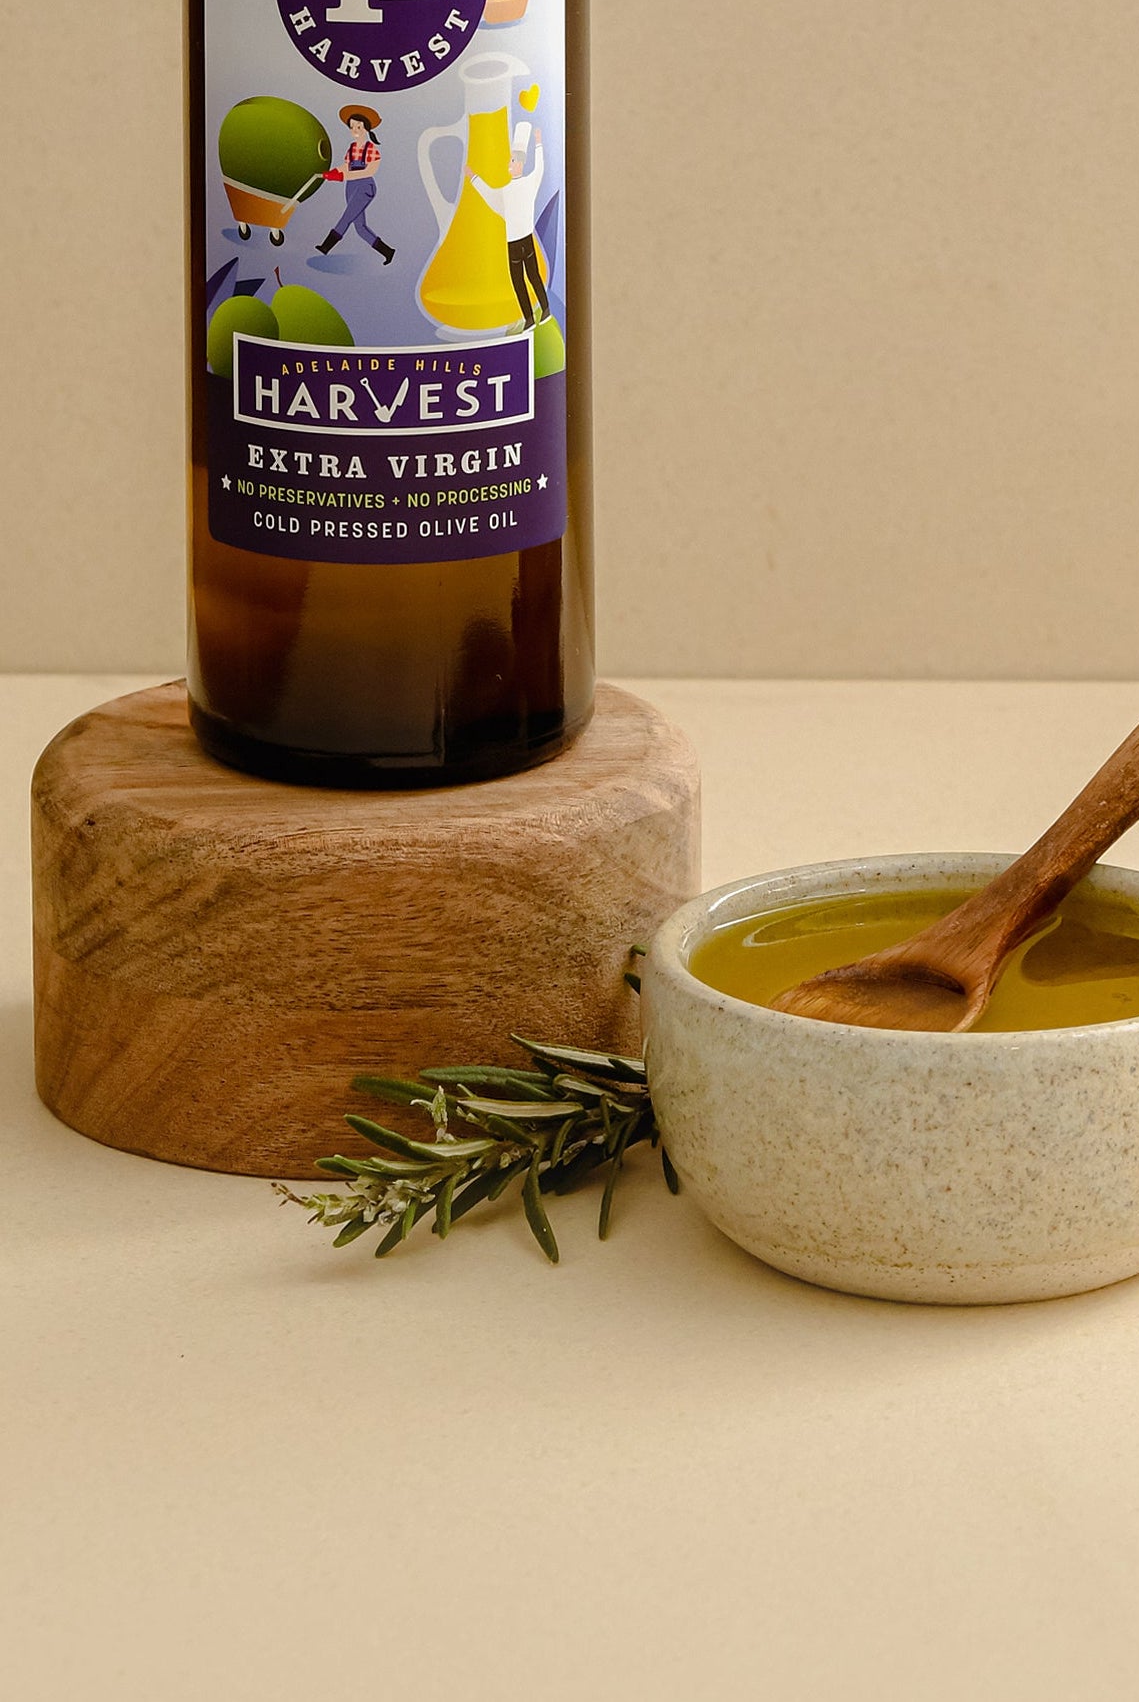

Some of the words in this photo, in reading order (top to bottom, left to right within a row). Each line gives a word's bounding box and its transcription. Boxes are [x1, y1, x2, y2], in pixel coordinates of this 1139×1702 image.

[290, 6, 469, 82] HARVEST
[281, 358, 396, 376] ADELAIDE
[416, 360, 482, 376] HILLS
[255, 374, 512, 423] HARVEST
[247, 443, 367, 479] EXTRA
[388, 442, 523, 479] VIRGIN
[237, 478, 255, 497] NO
[259, 481, 385, 509] PRESERVATIVES
[407, 492, 430, 508] NO
[436, 477, 532, 506] PROCESSING
[253, 510, 300, 534] COLD
[310, 519, 408, 539] PRESSED
[419, 515, 479, 537] OLIVE
[489, 510, 518, 529] OIL
